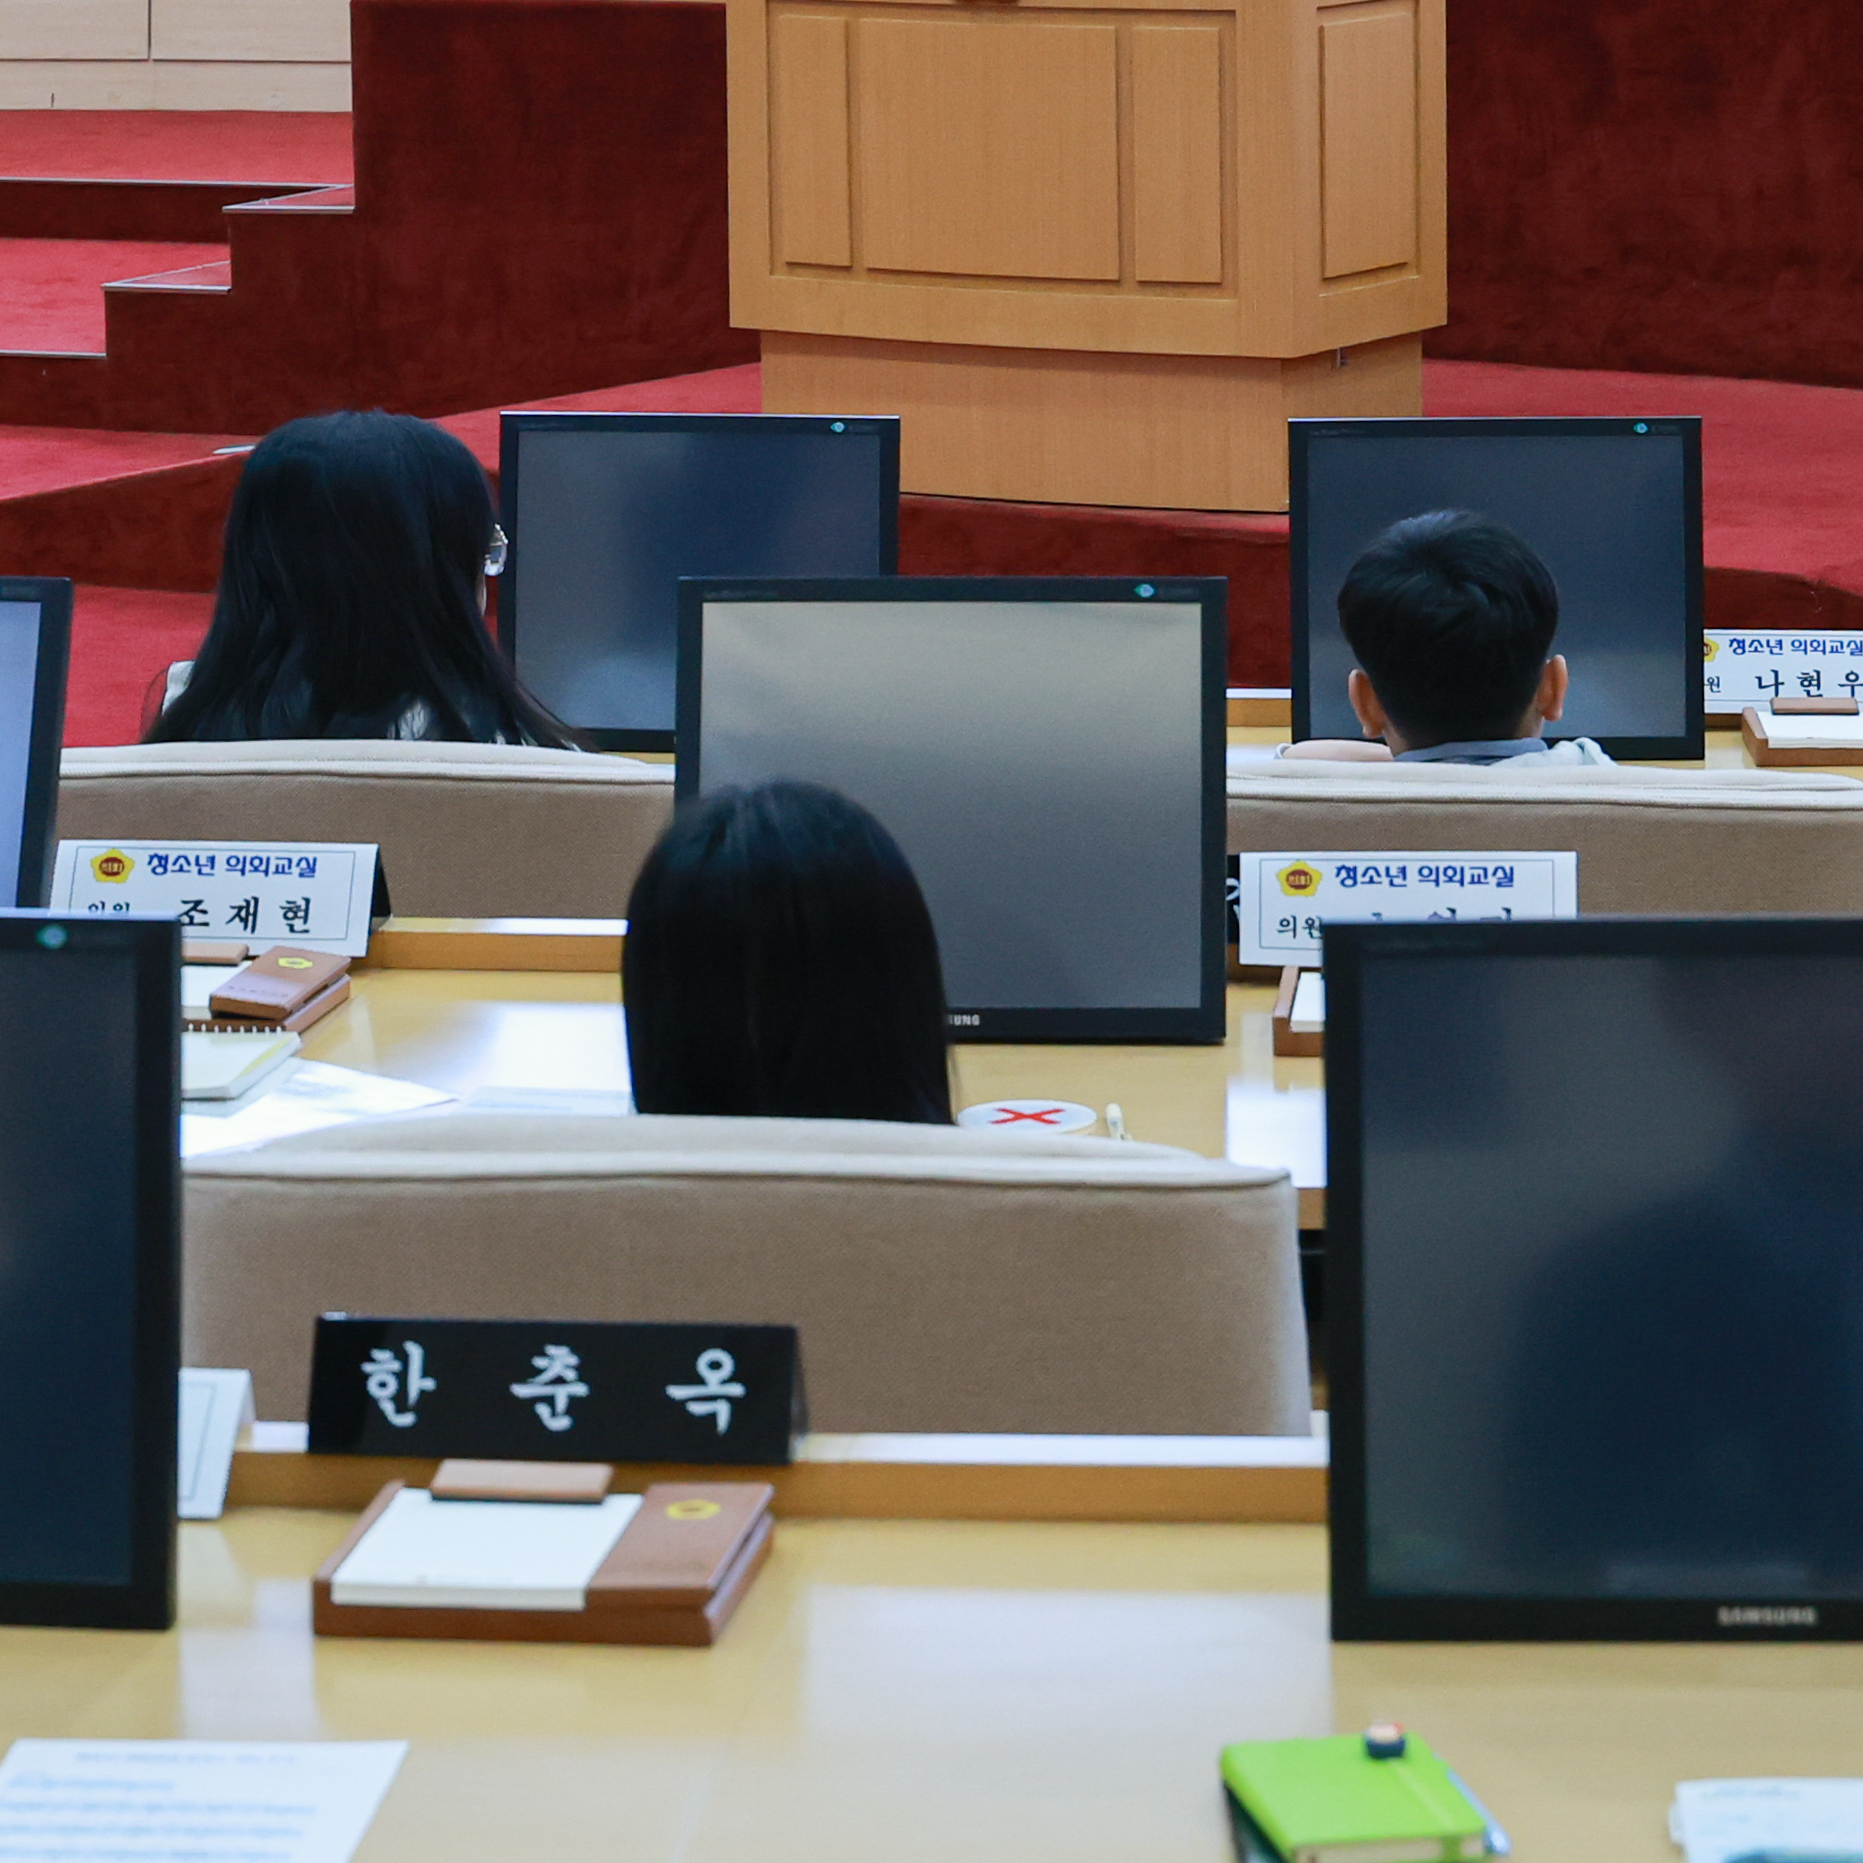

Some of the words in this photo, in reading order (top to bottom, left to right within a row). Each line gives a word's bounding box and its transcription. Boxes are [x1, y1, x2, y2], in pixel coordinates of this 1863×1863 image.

[1728, 638, 1784, 656] 청소년
[147, 853, 216, 877] 청소년
[225, 855, 318, 878] 의회교실
[1335, 864, 1408, 888] 청소년
[1417, 865, 1516, 888] 의회교실
